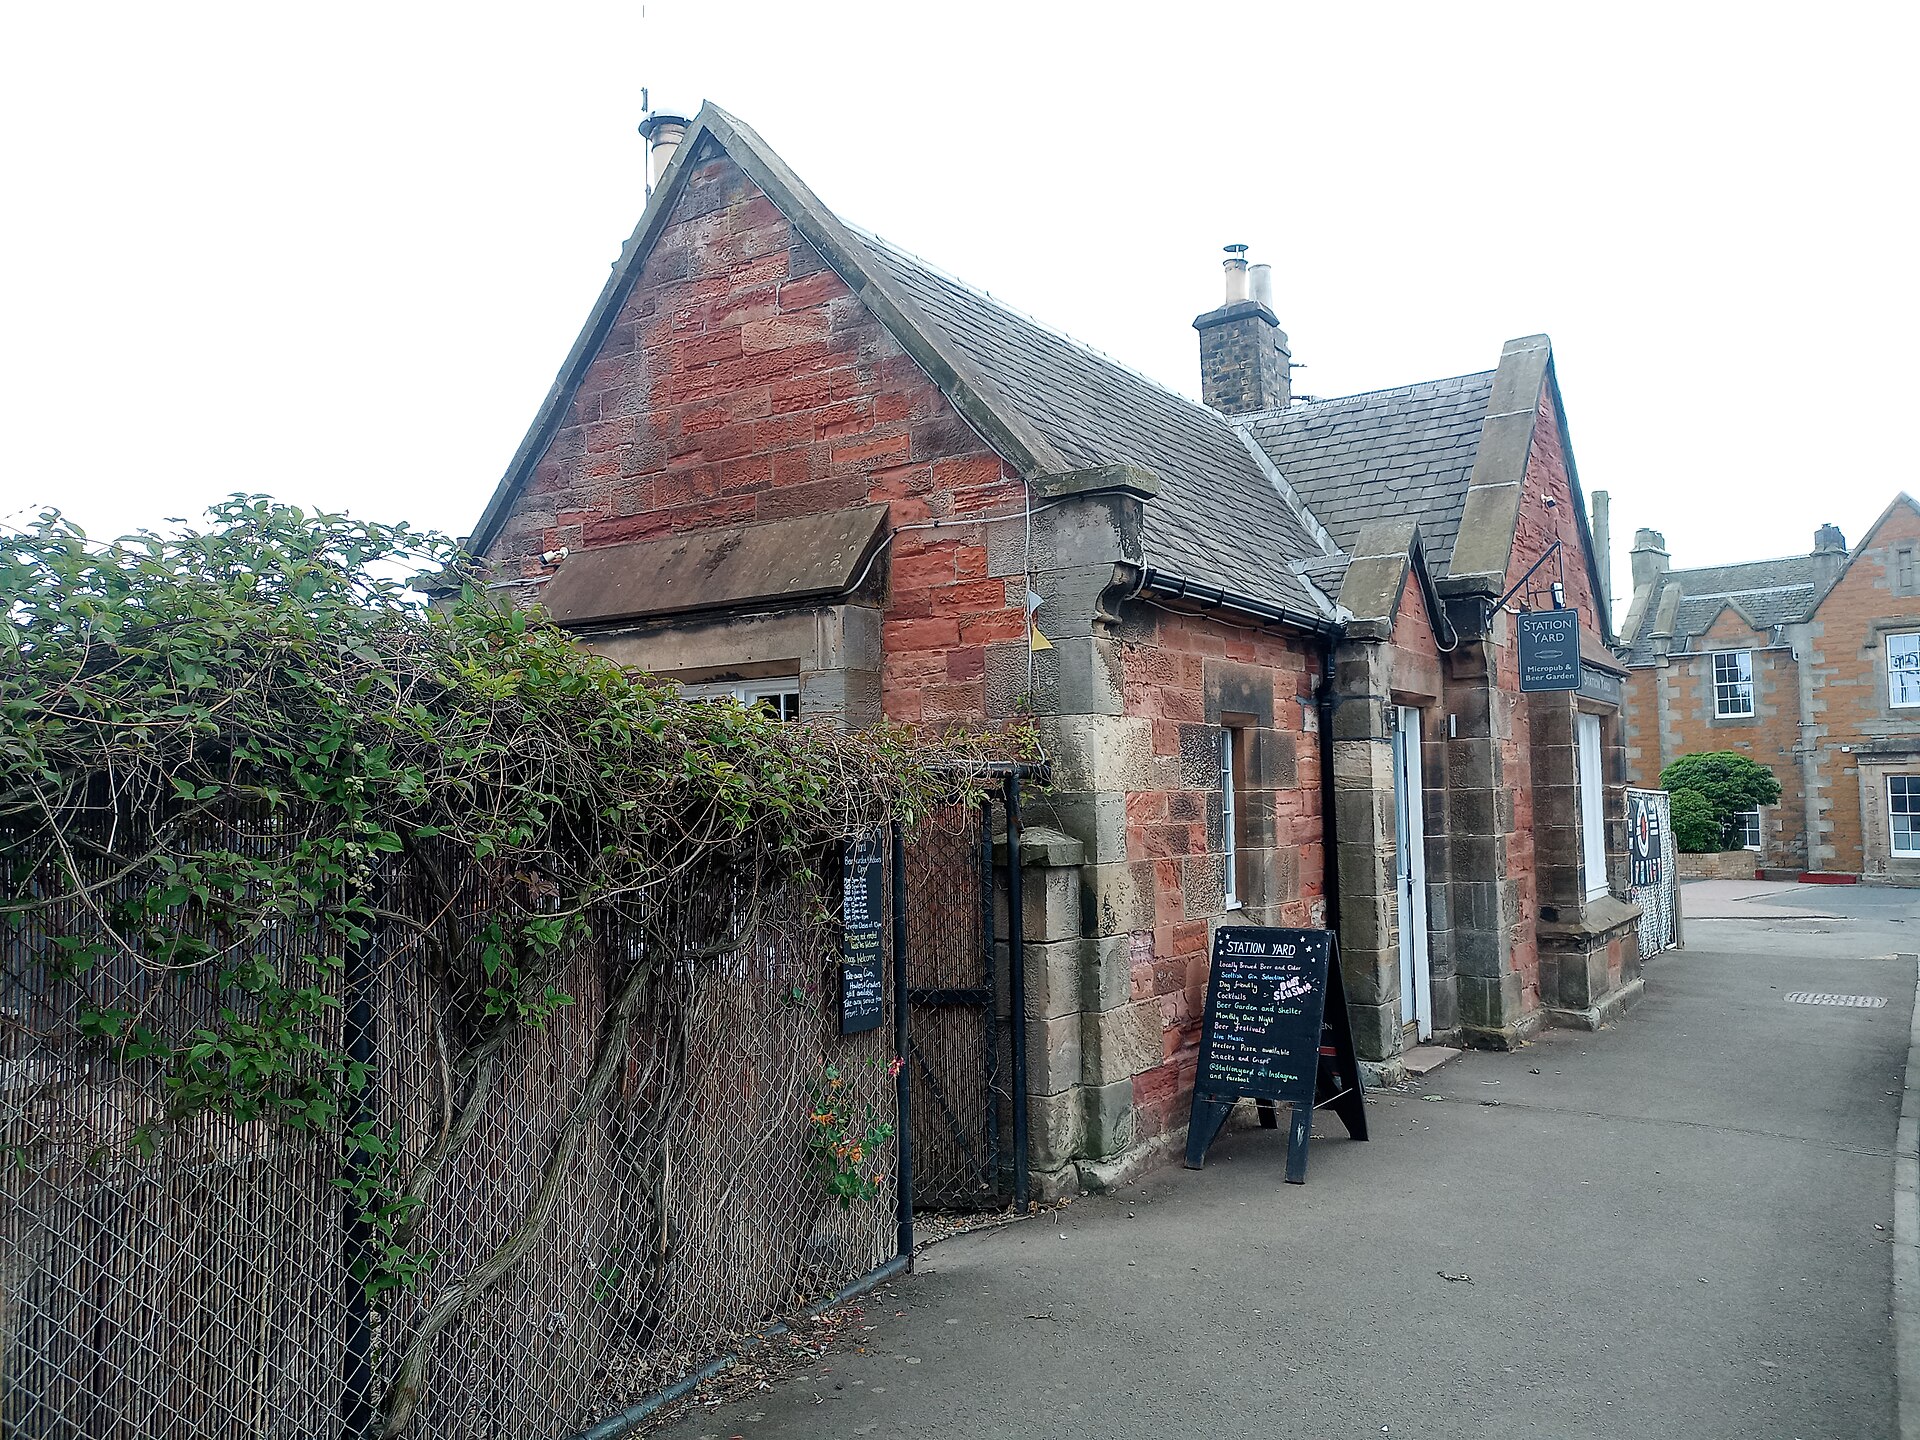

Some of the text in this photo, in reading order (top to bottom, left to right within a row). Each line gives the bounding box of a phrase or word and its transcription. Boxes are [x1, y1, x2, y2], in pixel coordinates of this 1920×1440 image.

[1524, 620, 1572, 631] STATION
[1532, 633, 1564, 643] YARD
[1528, 664, 1563, 673] Micropub
[1226, 942, 1296, 956] STATION YARD
[1219, 961, 1238, 972] Locally
[1219, 981, 1230, 991] Dog
[1217, 992, 1246, 1000] Cocktails
[1216, 1001, 1232, 1010] Beer
[1234, 1002, 1257, 1011] Garden
[1216, 1012, 1274, 1026] Monthly Quiz Night
[1214, 1022, 1229, 1030] Beer
[1240, 1044, 1257, 1052] Pizza
[1262, 1047, 1290, 1056] available
[1210, 1051, 1234, 1061] Snacks
[1269, 1070, 1298, 1082] Instagram
